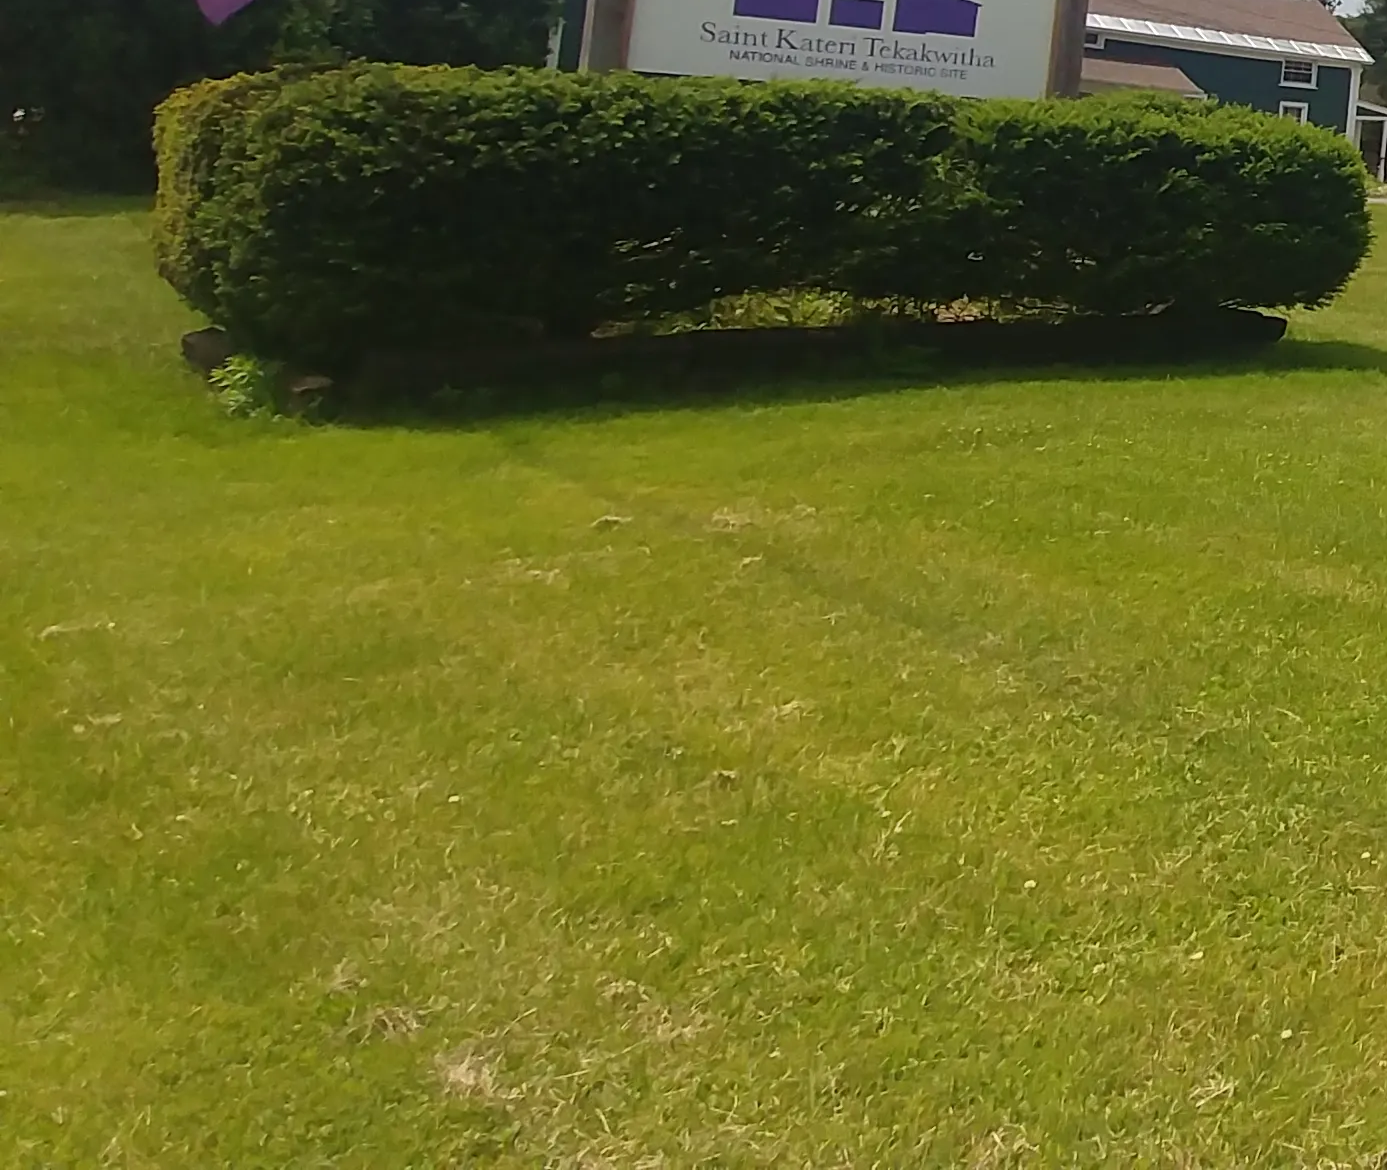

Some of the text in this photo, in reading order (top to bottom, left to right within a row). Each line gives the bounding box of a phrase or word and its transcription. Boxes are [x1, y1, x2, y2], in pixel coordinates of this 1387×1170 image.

[700, 21, 996, 68] Saint Kateri Tekakwitha
[729, 49, 968, 80] NATIONAL SHRINE & HISTORIC SITE
